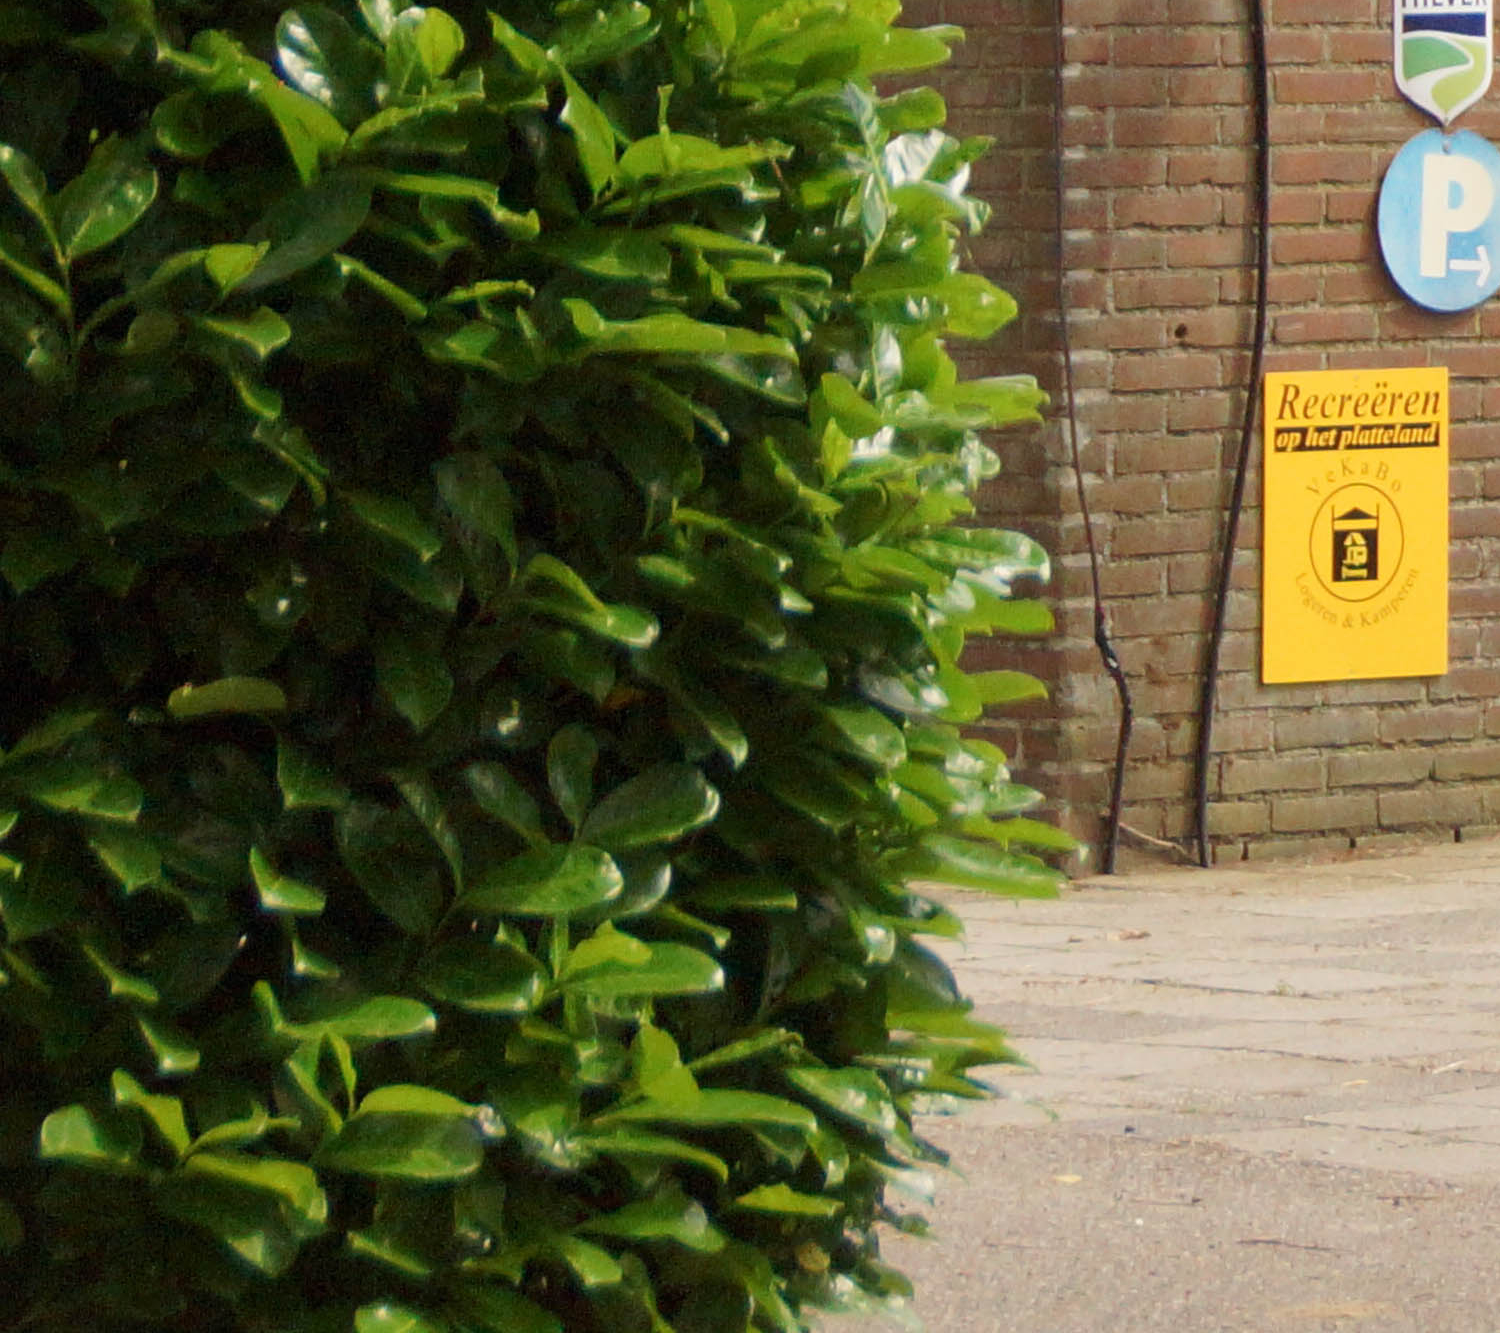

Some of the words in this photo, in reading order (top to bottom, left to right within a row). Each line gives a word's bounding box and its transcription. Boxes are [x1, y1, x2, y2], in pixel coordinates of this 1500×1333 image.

[1420, 153, 1495, 278] P
[1276, 382, 1440, 421] Recreëren
[1276, 431, 1301, 452] op
[1305, 425, 1337, 447] het
[1338, 421, 1436, 451] platteland
[1306, 457, 1401, 496] VeKaBo
[1360, 568, 1419, 627] Kamperen
